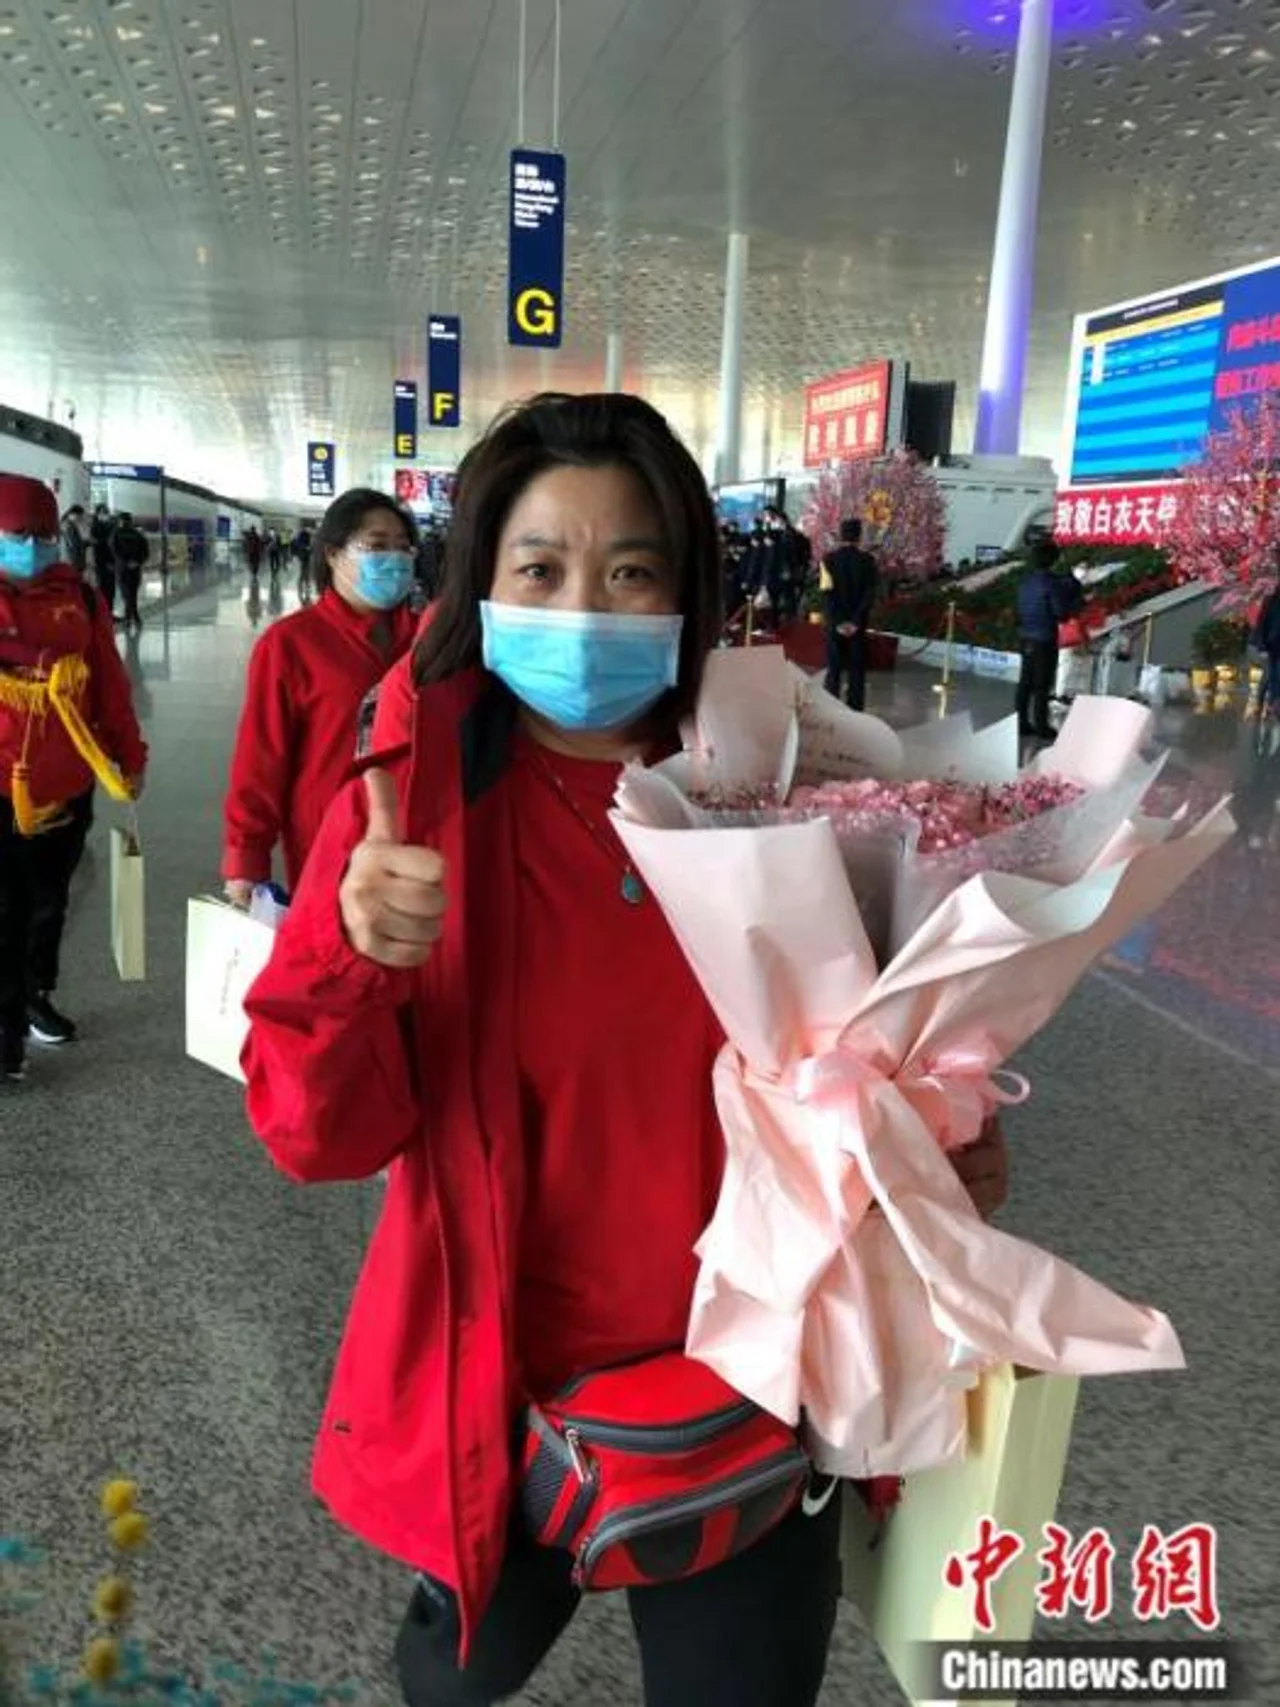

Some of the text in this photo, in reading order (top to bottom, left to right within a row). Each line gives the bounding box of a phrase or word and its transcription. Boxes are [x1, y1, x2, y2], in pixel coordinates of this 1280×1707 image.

[516, 288, 555, 335] G
[432, 392, 454, 420] F
[397, 434, 414, 455] E
